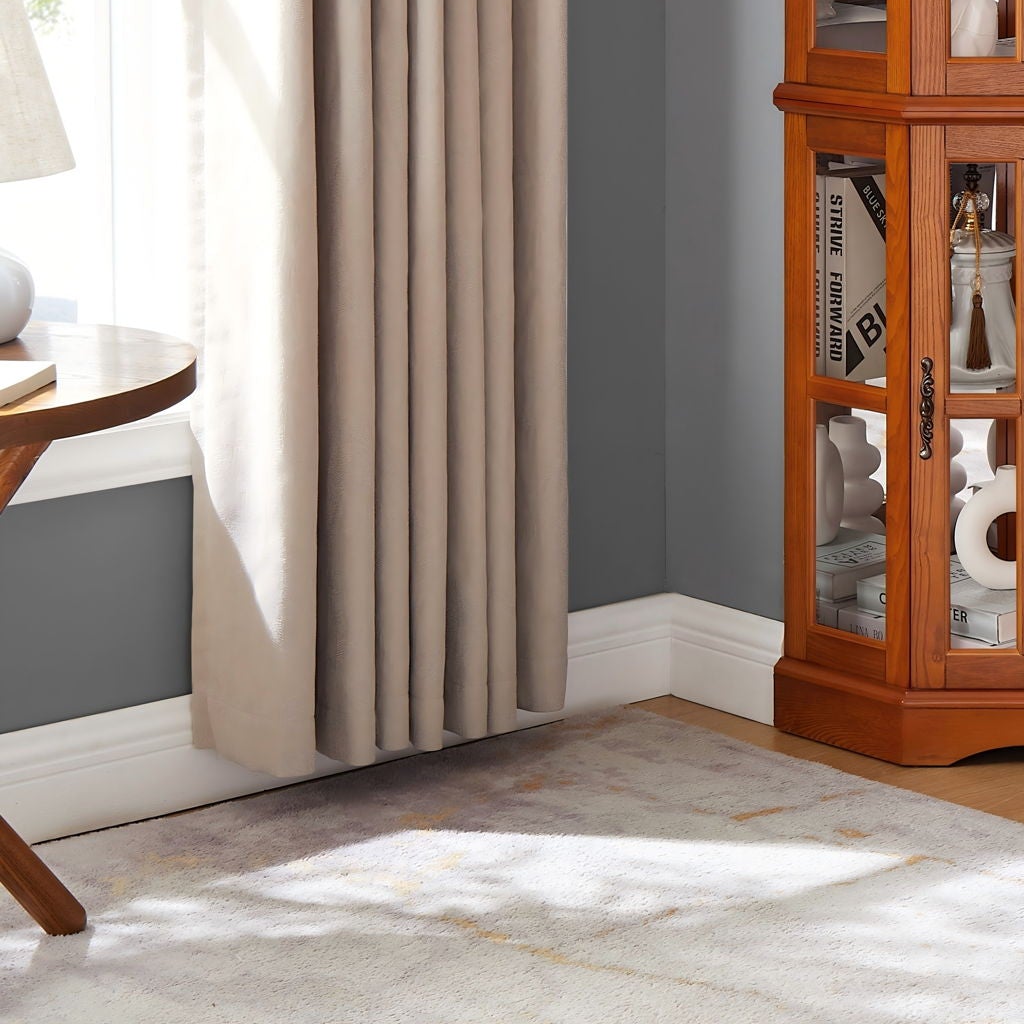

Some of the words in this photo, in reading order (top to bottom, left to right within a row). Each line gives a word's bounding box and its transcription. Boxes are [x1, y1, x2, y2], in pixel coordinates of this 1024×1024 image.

[830, 194, 843, 257] STRIVE
[862, 184, 881, 212] BLUE
[829, 271, 843, 362] FORWARD
